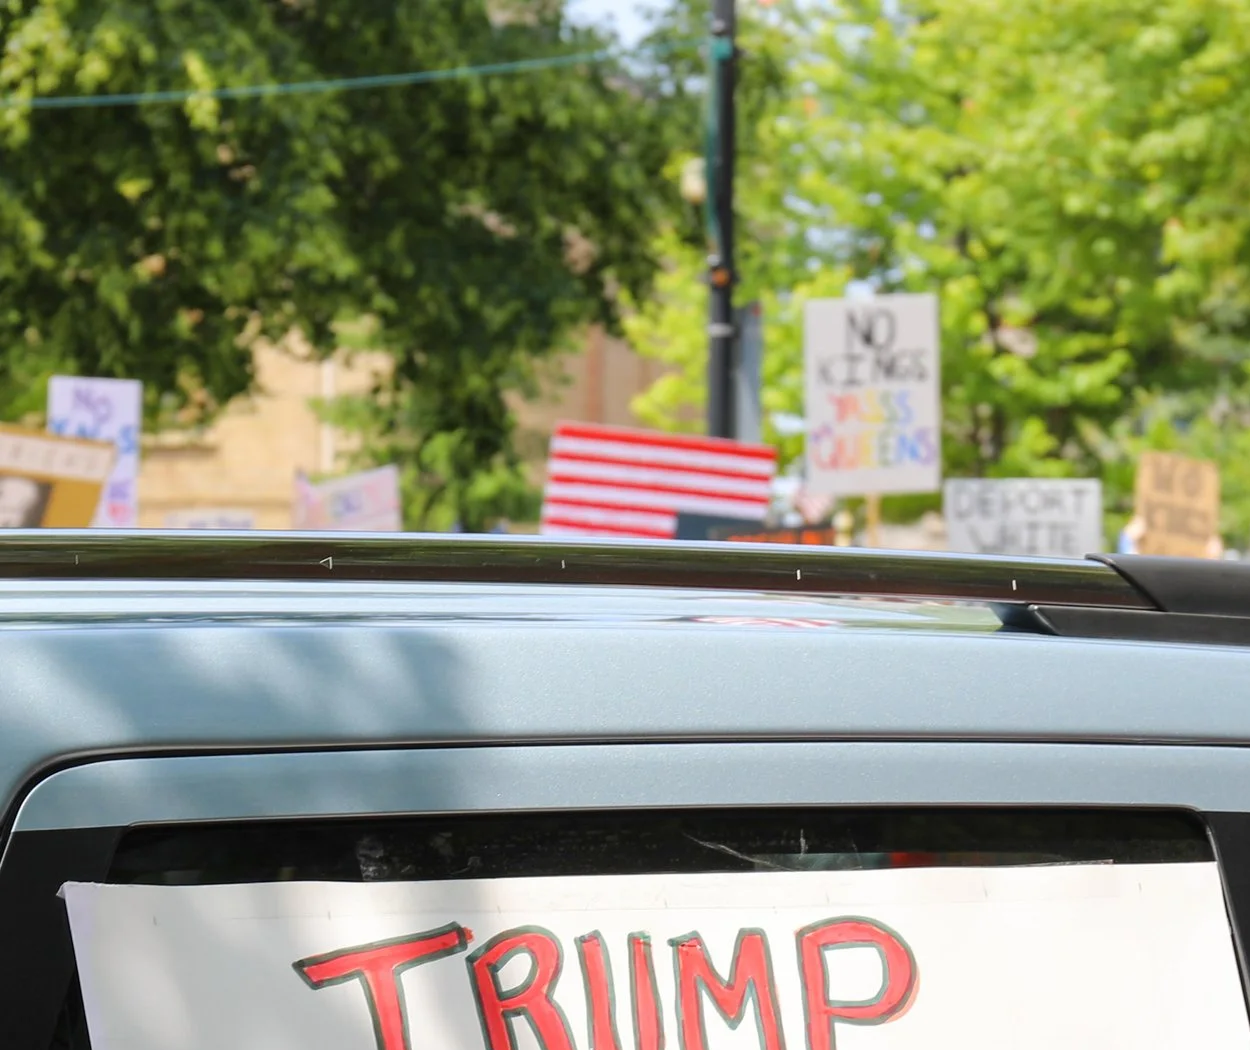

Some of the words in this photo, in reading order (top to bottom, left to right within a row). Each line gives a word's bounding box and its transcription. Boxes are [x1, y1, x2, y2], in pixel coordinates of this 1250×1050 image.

[846, 308, 896, 350] NO
[816, 349, 929, 387] KINGS
[809, 423, 938, 470] QUEENS
